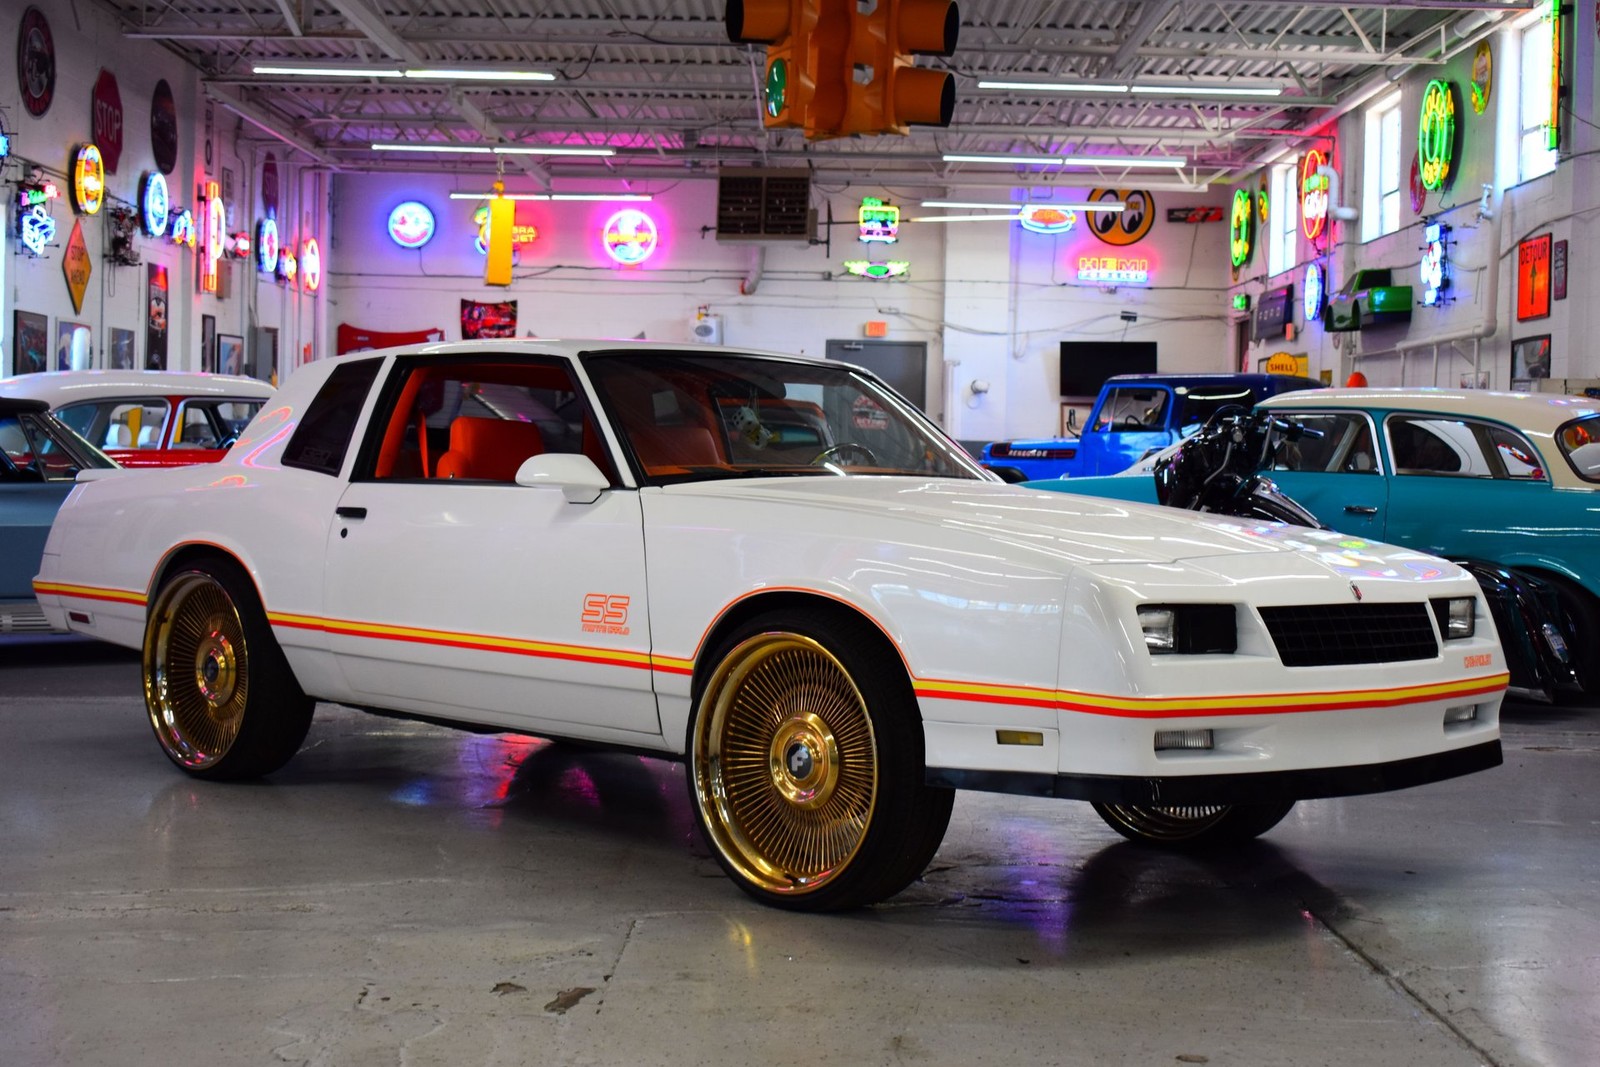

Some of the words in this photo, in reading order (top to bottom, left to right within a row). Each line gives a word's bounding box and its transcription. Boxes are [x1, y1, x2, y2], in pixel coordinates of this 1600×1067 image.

[95, 99, 121, 142] STOP
[511, 226, 535, 234] BRA
[71, 245, 85, 262] STOP
[1519, 242, 1548, 267] DETOUR
[1079, 257, 1148, 272] HEMI
[1258, 306, 1281, 324] FORD
[1269, 363, 1294, 372] SHELL
[1008, 449, 1048, 458] RENEGADE
[581, 593, 630, 625] SS
